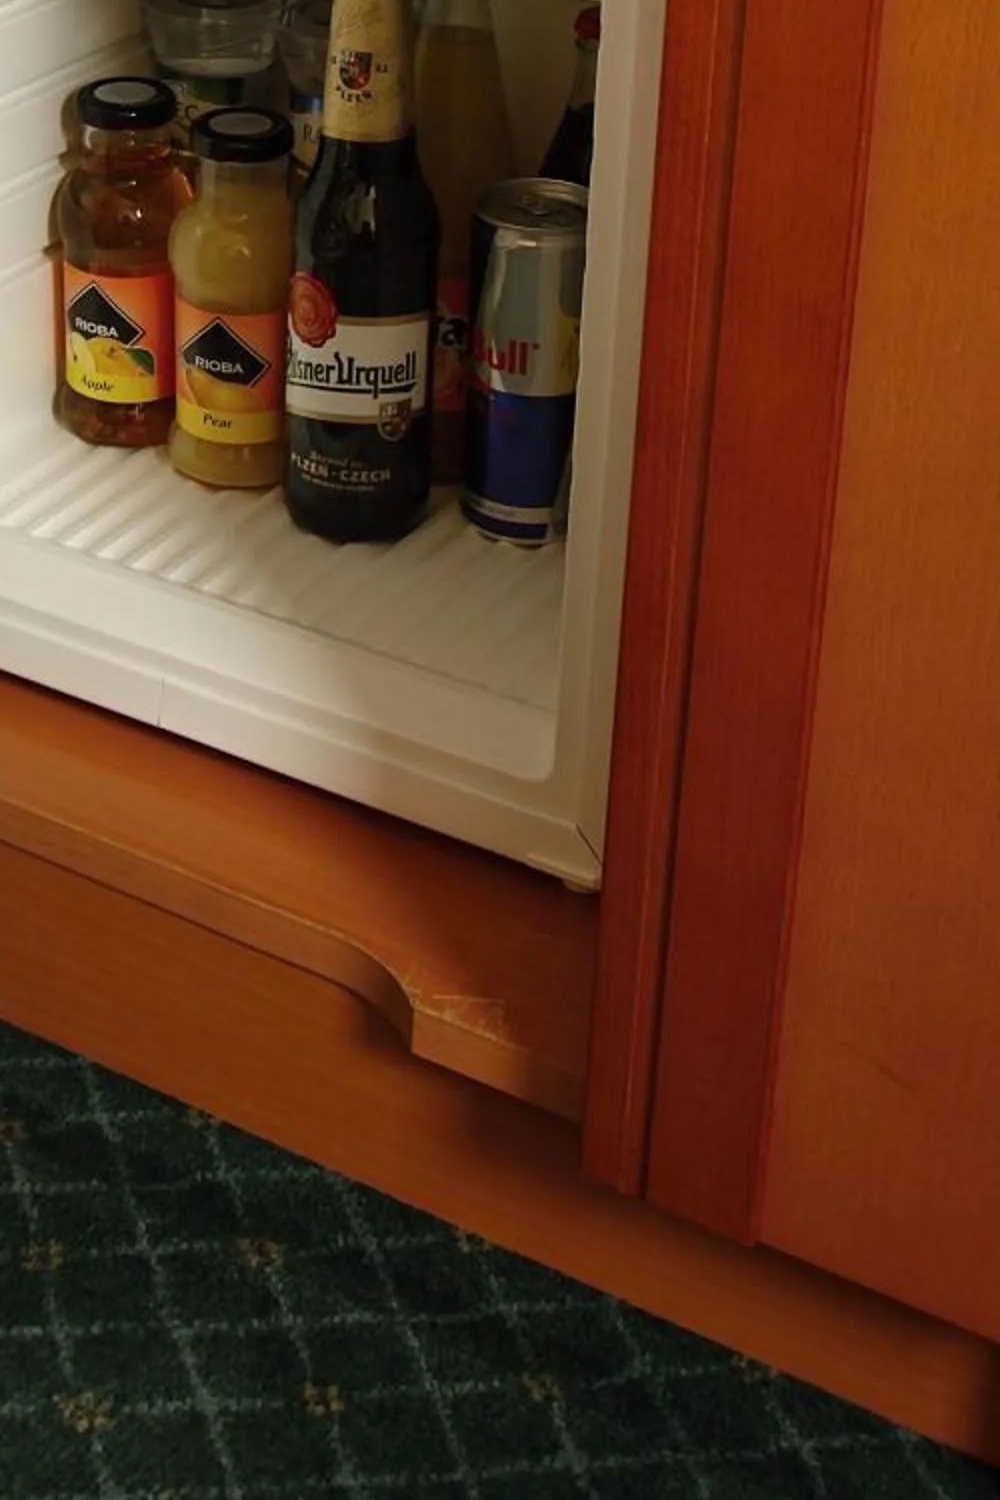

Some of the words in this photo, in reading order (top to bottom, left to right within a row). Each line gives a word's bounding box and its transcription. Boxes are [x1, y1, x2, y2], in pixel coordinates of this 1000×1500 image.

[75, 316, 119, 338] RIOBA
[195, 355, 244, 375] RIOBA
[287, 342, 335, 383] lsner
[333, 351, 417, 400] Urquell
[203, 413, 233, 430] Pear
